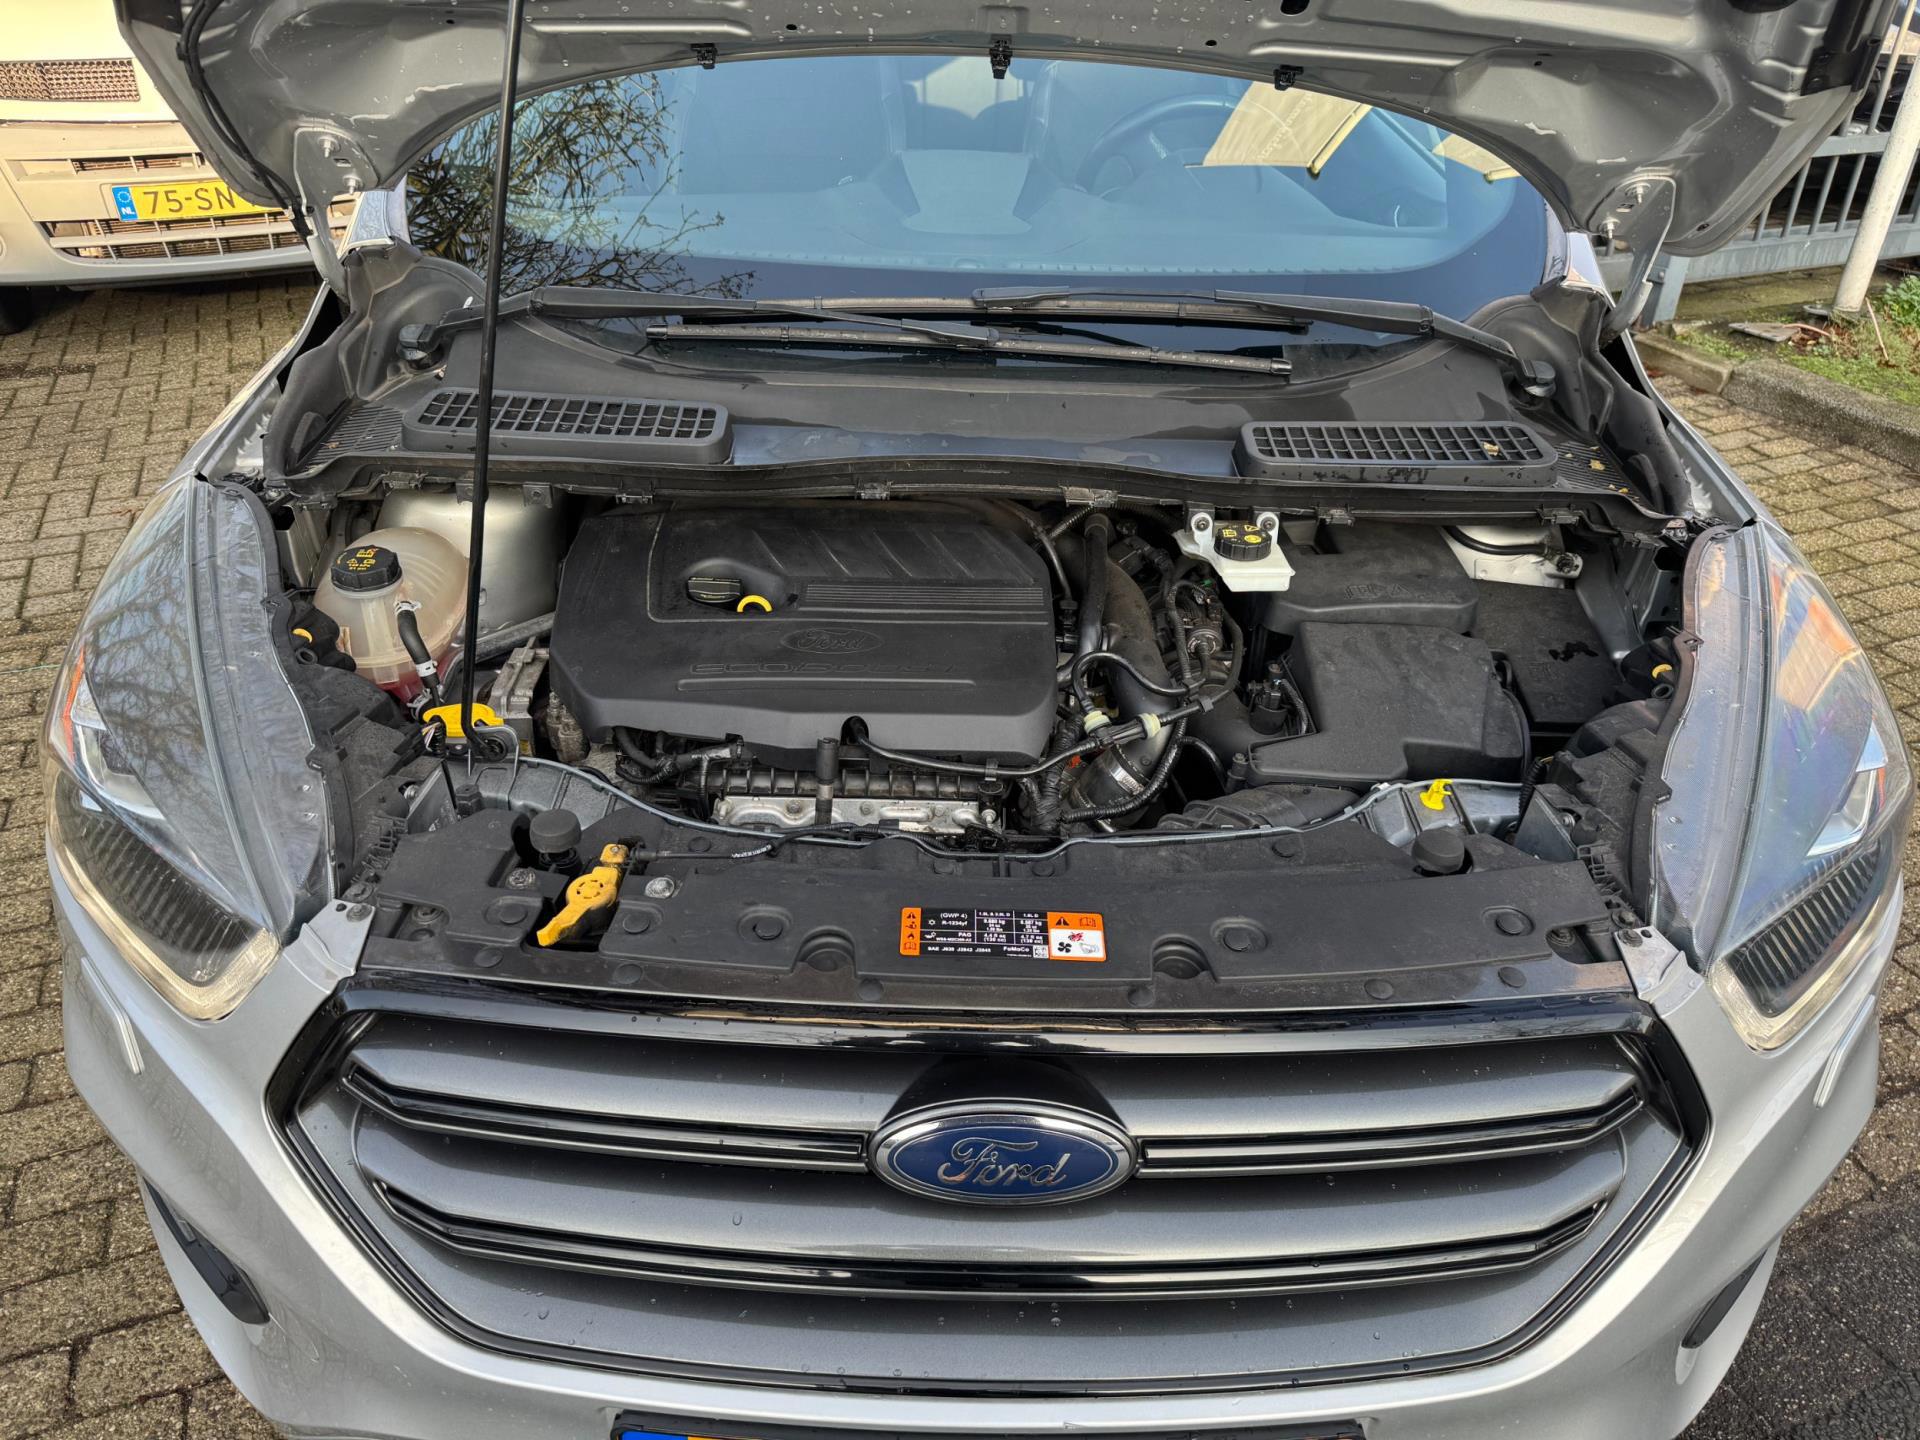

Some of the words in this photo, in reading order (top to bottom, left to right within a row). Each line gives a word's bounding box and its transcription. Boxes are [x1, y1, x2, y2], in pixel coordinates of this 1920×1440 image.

[121, 207, 135, 215] NL
[142, 187, 236, 215] 75-SN
[797, 629, 866, 651] Ford
[937, 1136, 1071, 1187] Ford
